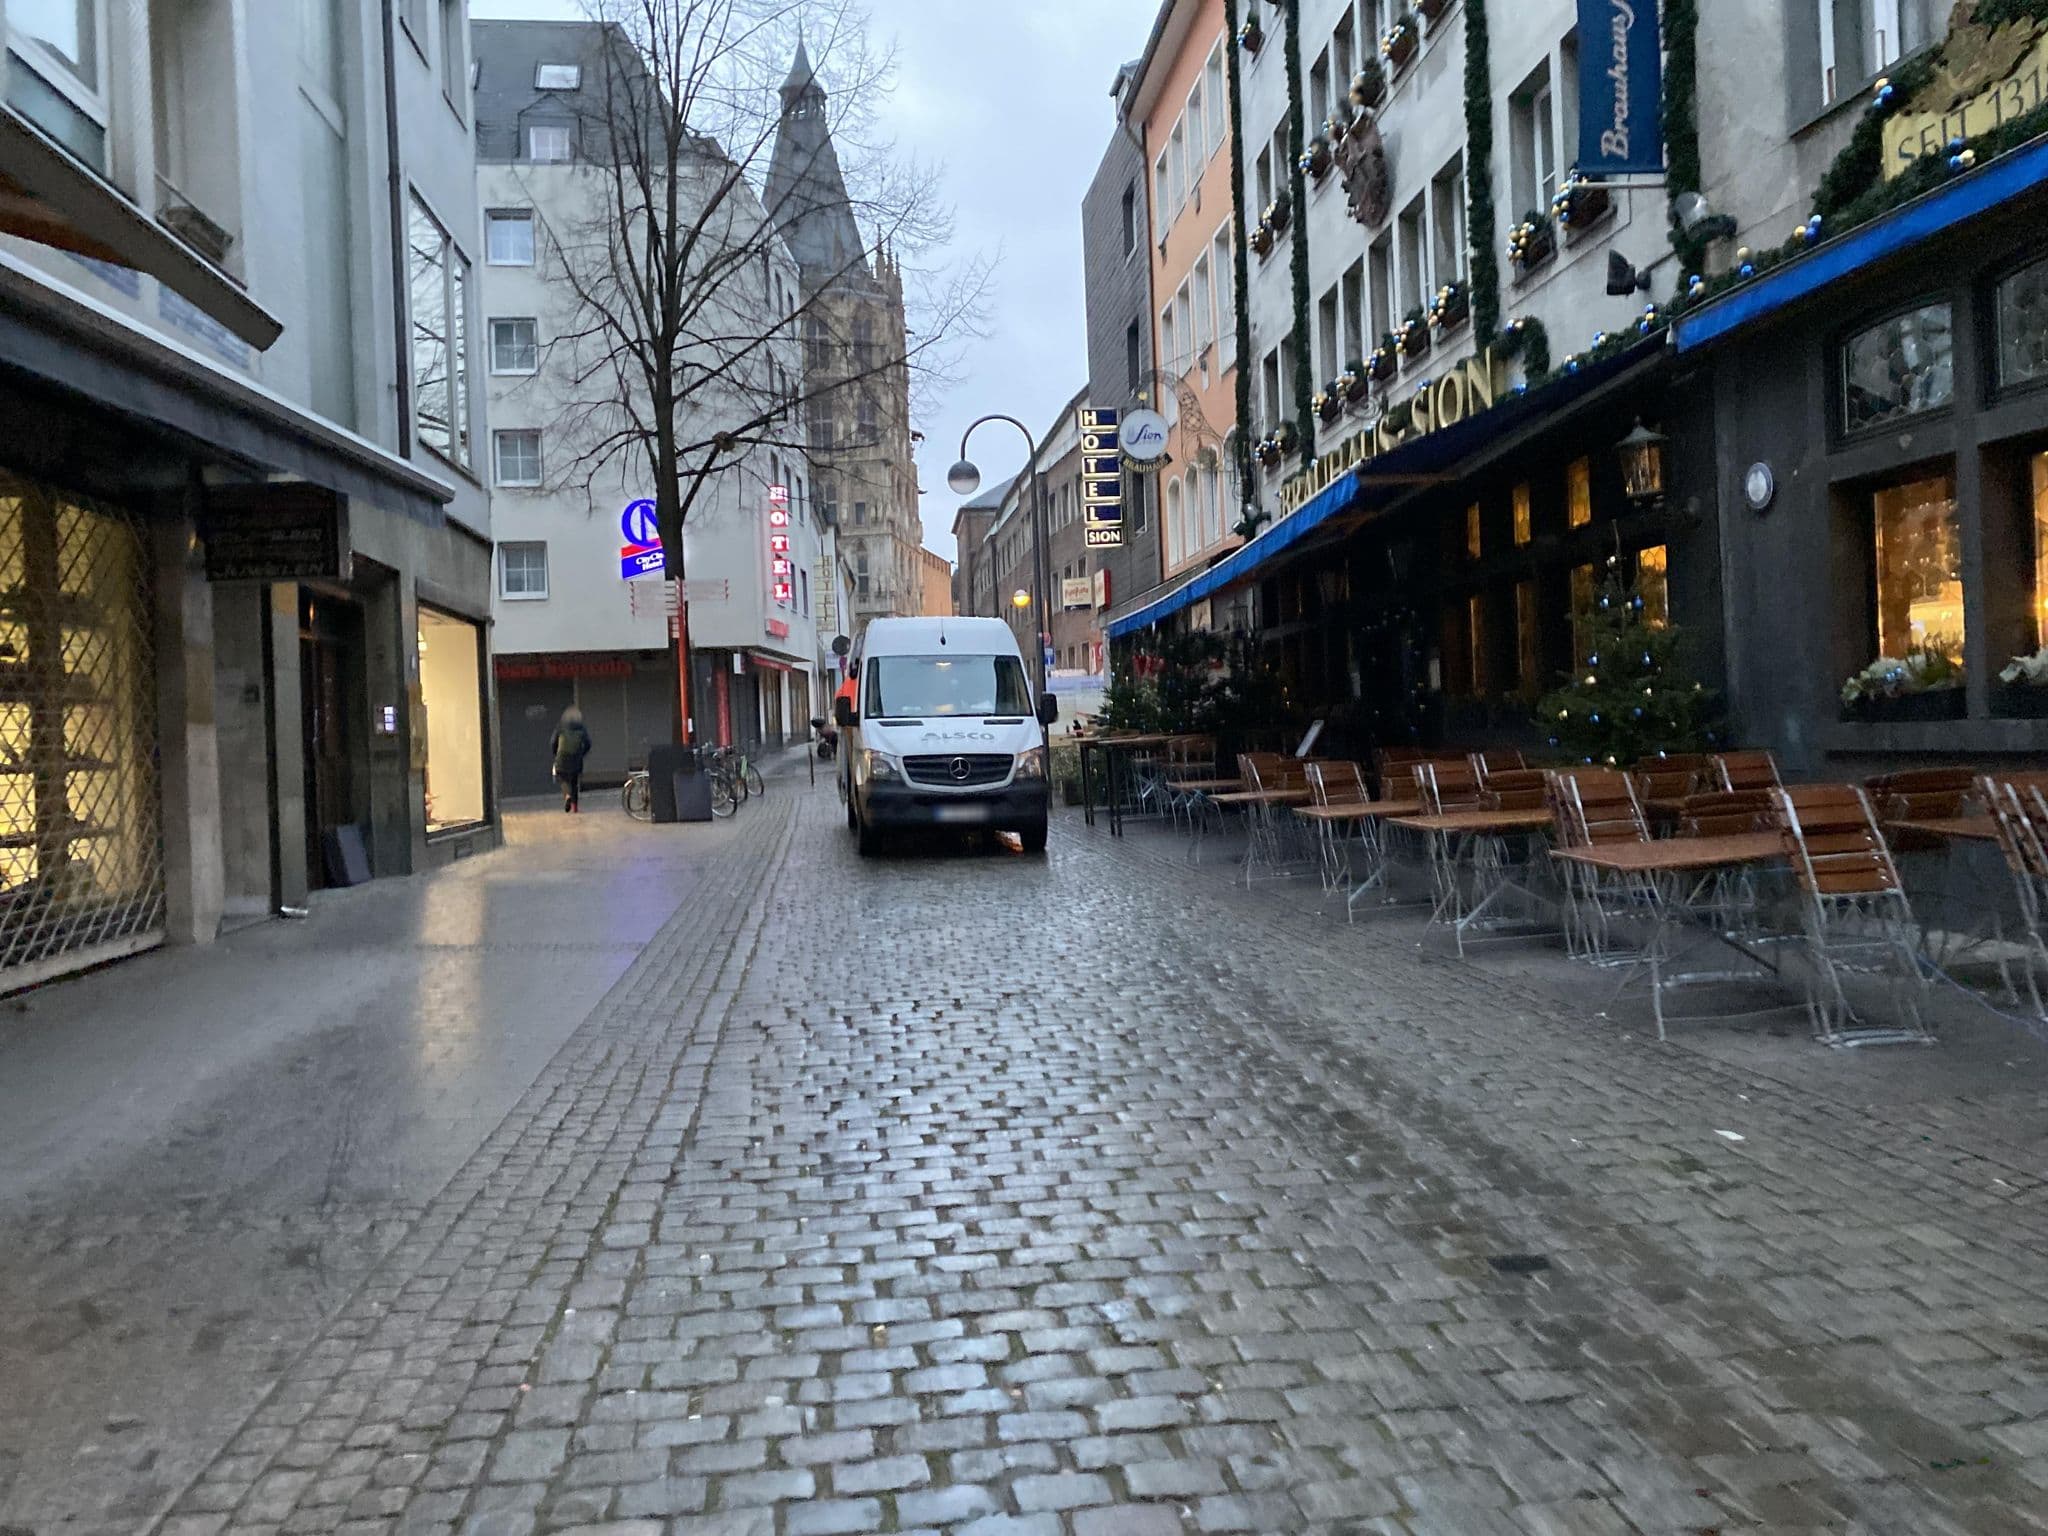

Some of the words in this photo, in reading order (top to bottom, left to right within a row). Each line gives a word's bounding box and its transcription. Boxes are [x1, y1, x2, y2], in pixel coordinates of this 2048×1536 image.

[1601, 13, 1629, 160] Brauhaus
[1898, 101, 1974, 159] SEIT
[1986, 63, 2048, 127] 131
[1126, 424, 1163, 445] Sion
[1411, 346, 1493, 436] SION
[1083, 410, 1100, 521] HOTEL
[769, 486, 792, 600] HOTEL
[1088, 531, 1120, 543] SION
[921, 732, 995, 741] ALSCO
